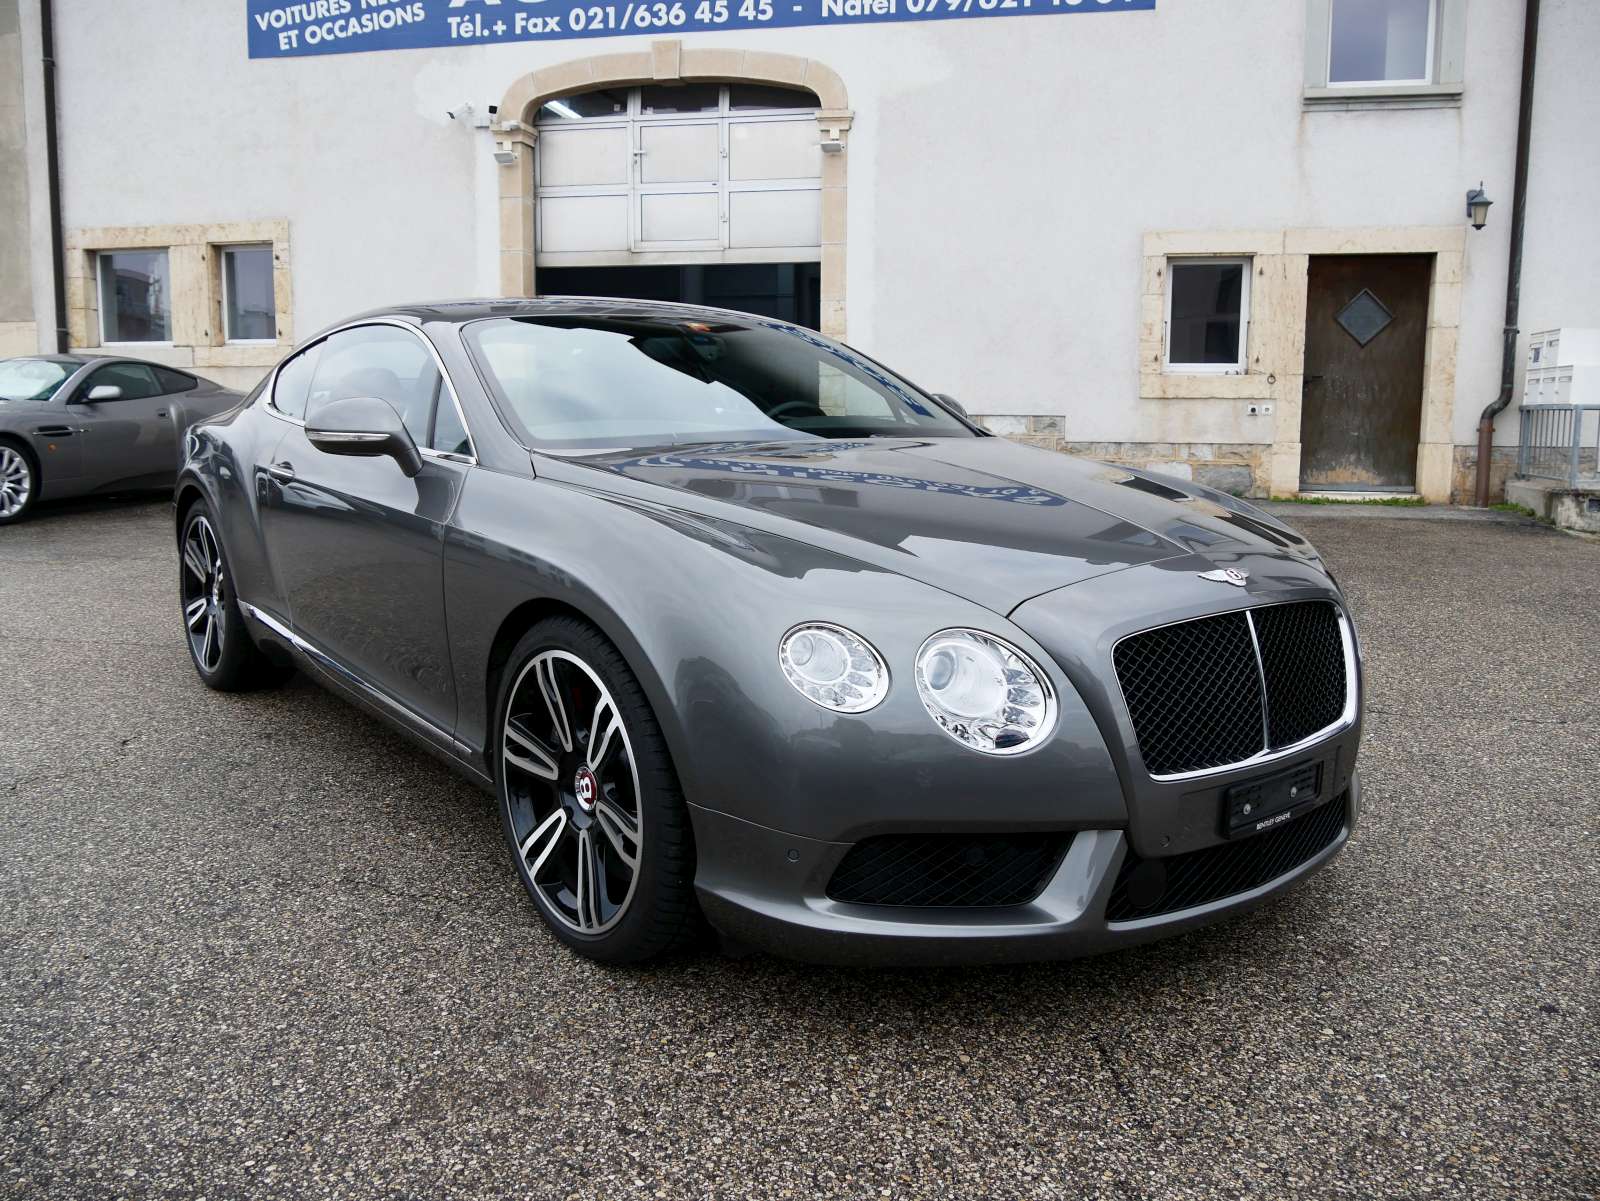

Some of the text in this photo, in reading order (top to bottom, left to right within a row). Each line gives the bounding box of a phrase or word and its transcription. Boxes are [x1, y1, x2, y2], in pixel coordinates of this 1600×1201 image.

[254, 0, 351, 31] VOITURES
[278, 3, 425, 50] ET OCCASIONS
[515, 12, 561, 34] Fax
[569, 3, 686, 31] 021/636
[694, 0, 729, 23] 45
[738, 0, 773, 21] 45
